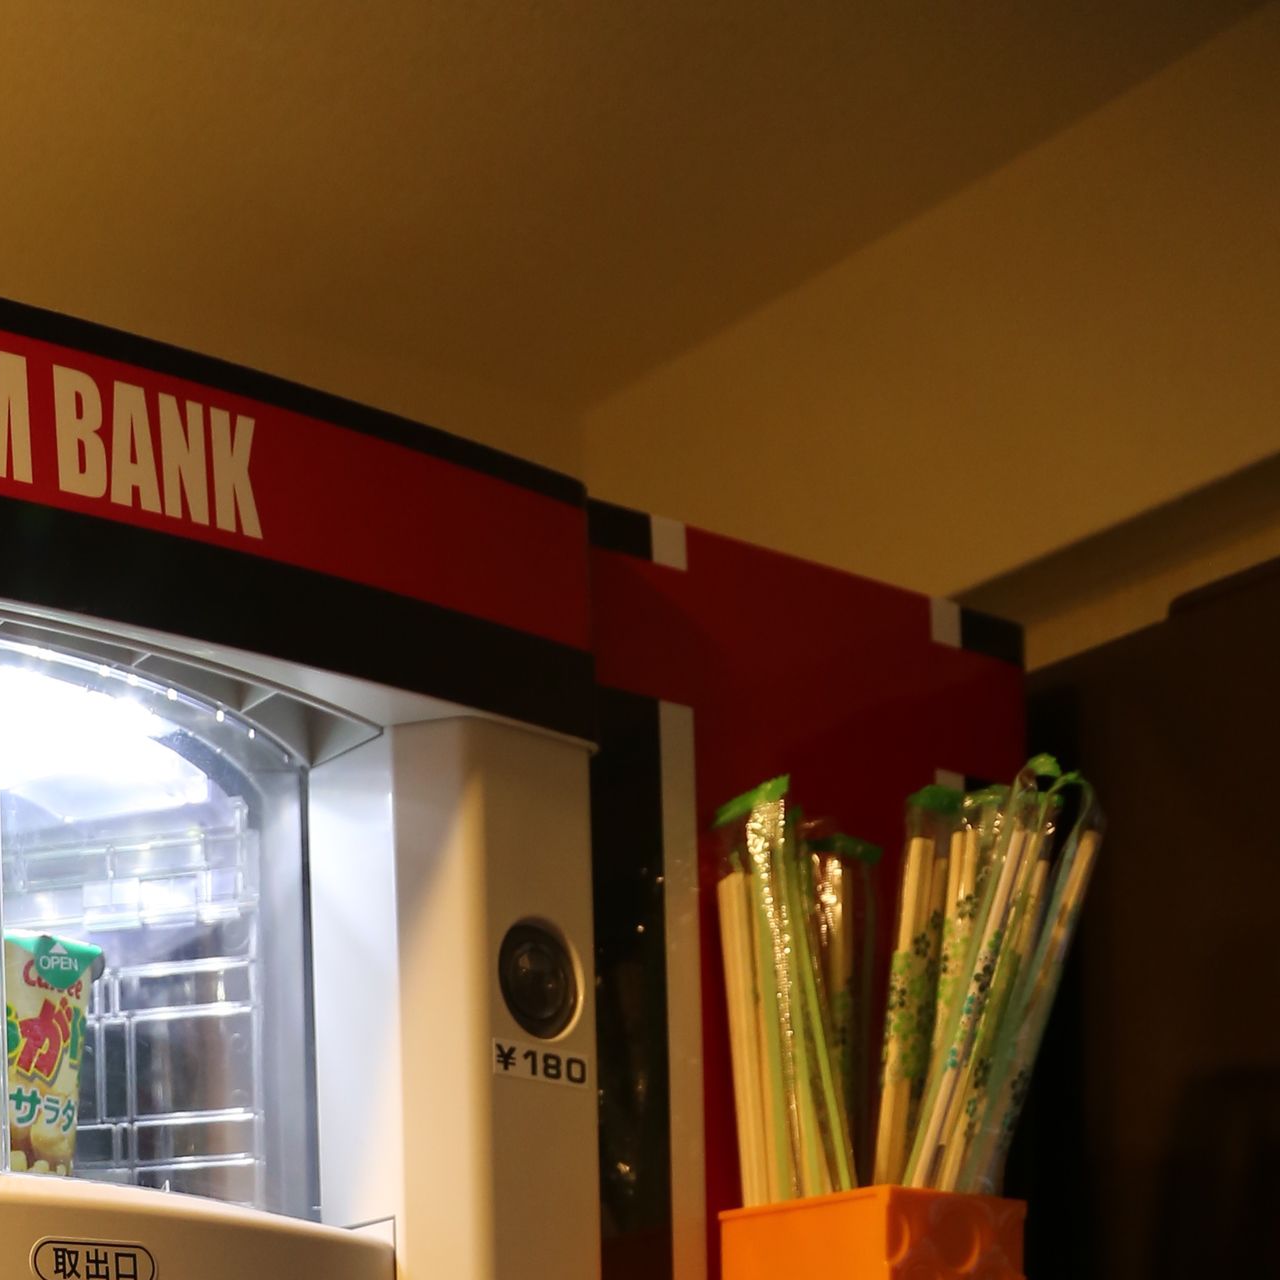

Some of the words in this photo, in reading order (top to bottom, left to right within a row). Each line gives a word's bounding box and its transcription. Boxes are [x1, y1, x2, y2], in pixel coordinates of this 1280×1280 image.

[52, 363, 264, 541] BANK
[39, 955, 79, 971] OPEN
[495, 1042, 586, 1084] ¥180
